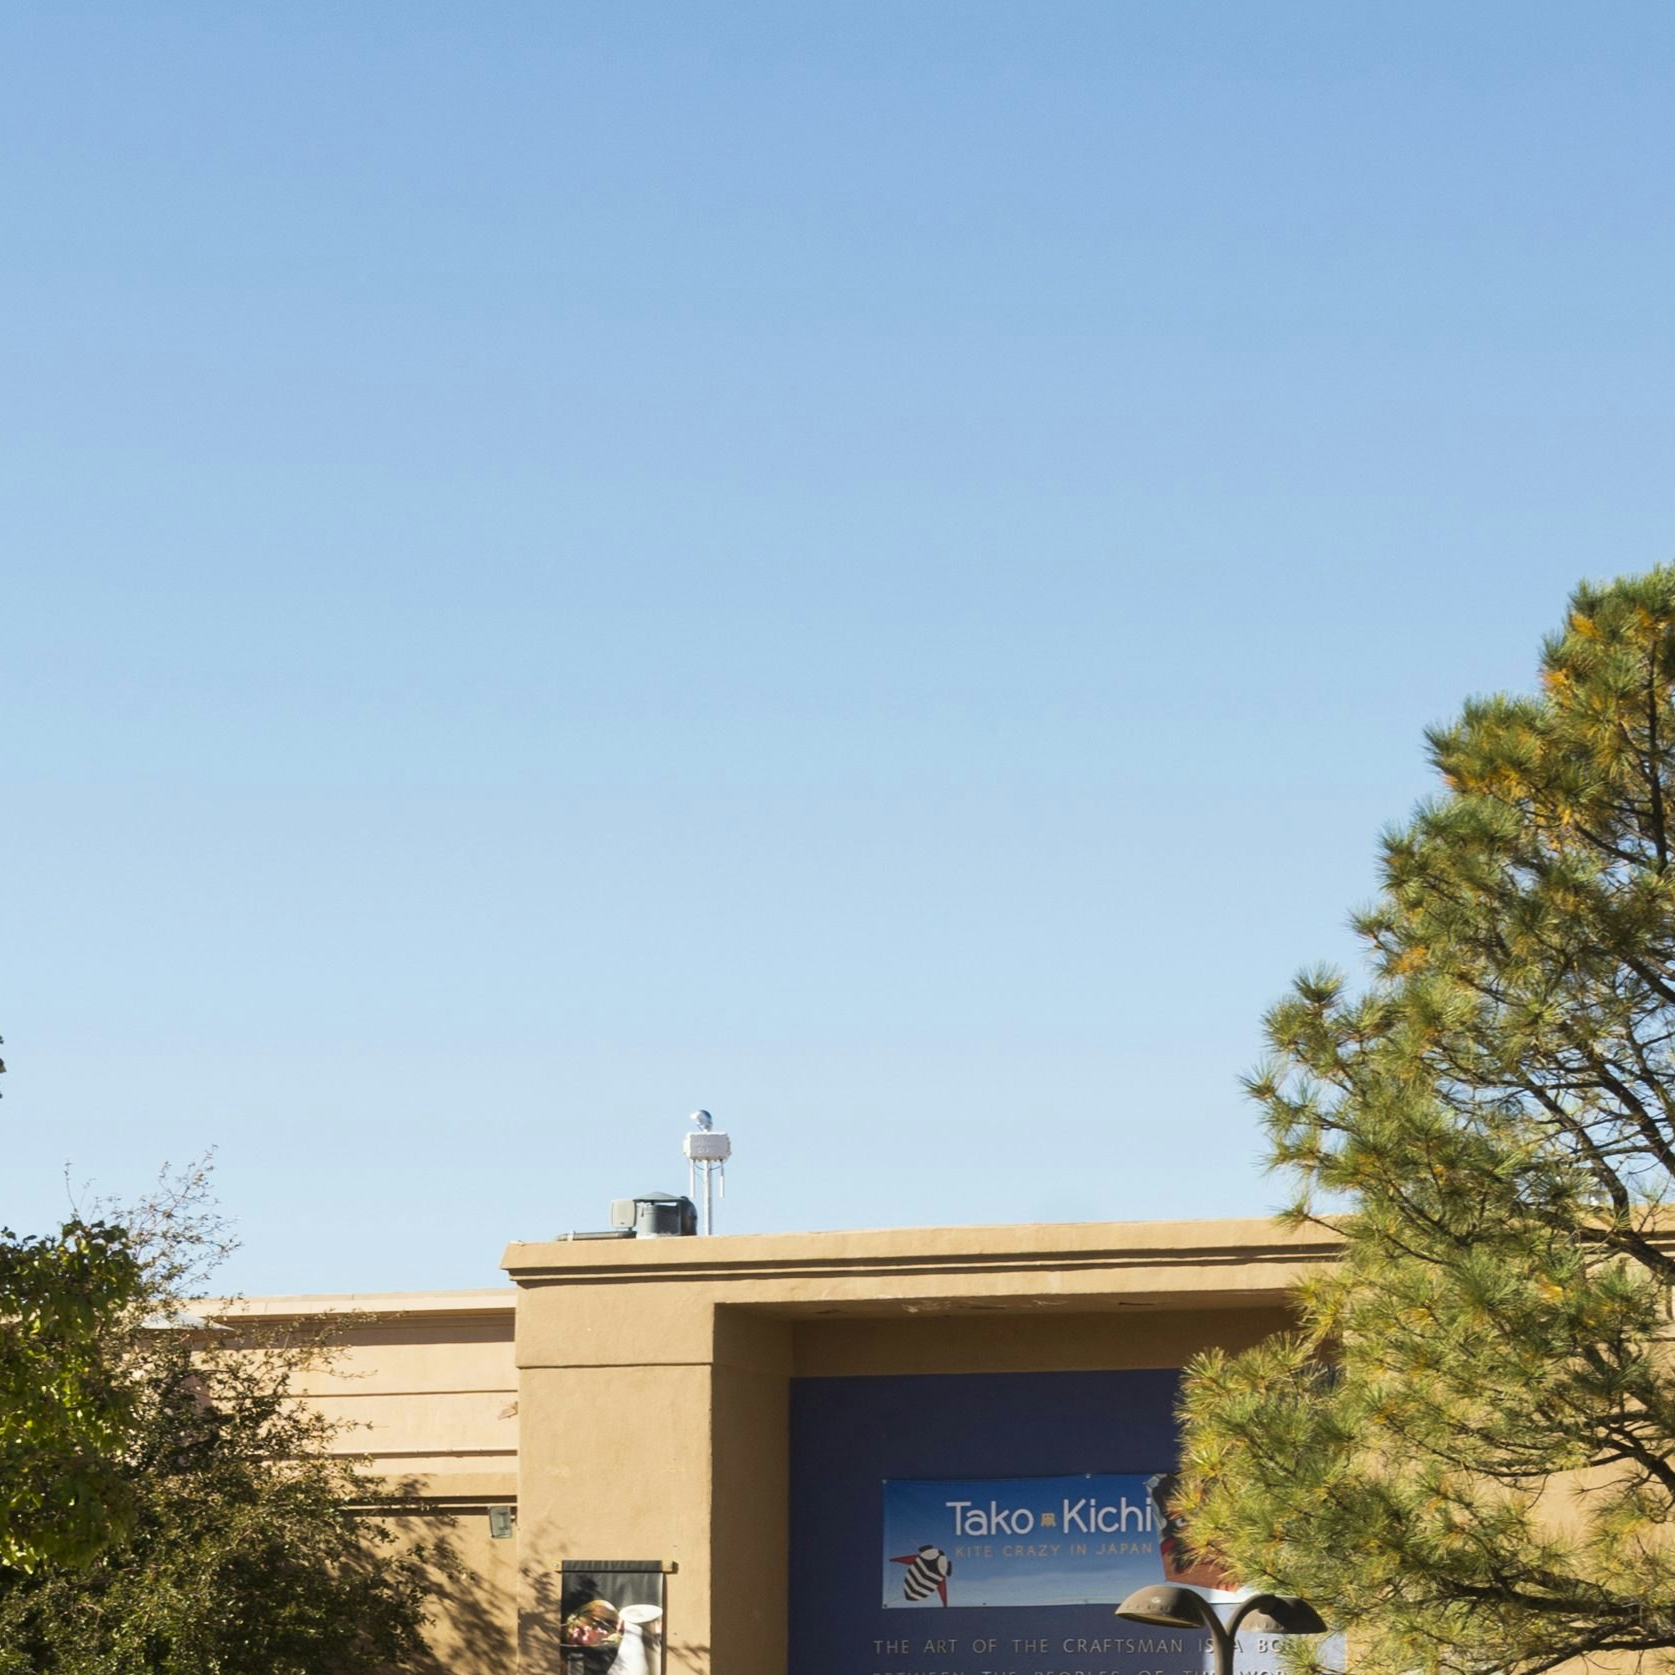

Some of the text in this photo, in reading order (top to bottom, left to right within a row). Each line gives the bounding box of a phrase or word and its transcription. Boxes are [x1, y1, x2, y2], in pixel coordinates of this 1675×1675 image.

[946, 1500, 1034, 1536] Tako
[1063, 1497, 1152, 1534] Kichi
[956, 1543, 1153, 1558] KITE CRAZY IN JAPAN
[873, 1639, 910, 1654] THE
[924, 1639, 957, 1653] ART
[972, 1639, 997, 1653] OF
[1012, 1639, 1048, 1653] THE
[1063, 1638, 1183, 1653] CRAFTSMAN
[1198, 1638, 1214, 1653] IS
